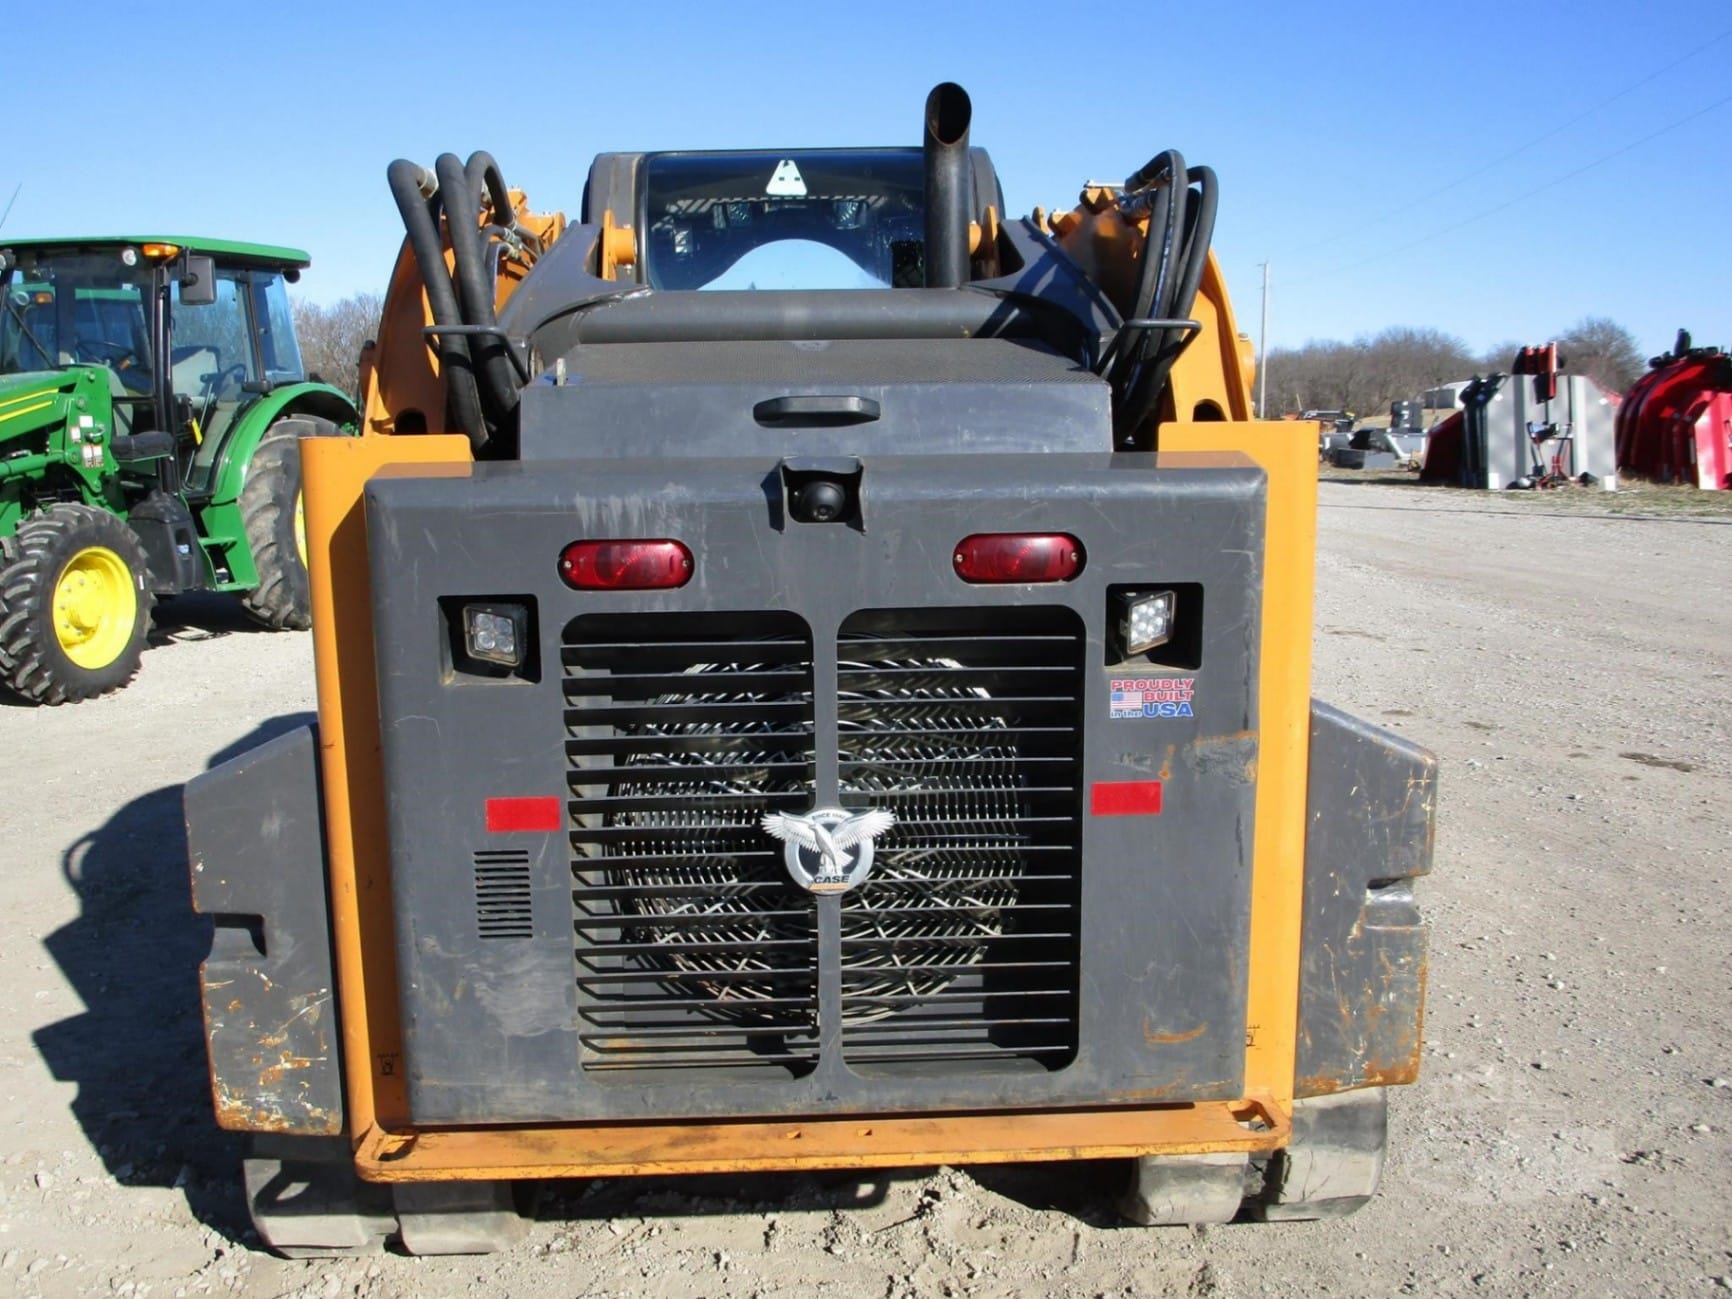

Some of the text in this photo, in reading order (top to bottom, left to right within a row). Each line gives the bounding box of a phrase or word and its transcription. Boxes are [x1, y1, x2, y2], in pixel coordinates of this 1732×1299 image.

[1110, 678, 1194, 691] PROUDLY
[1143, 690, 1194, 702] BUILT
[1143, 702, 1193, 718] USA
[814, 875, 849, 884] CASE
